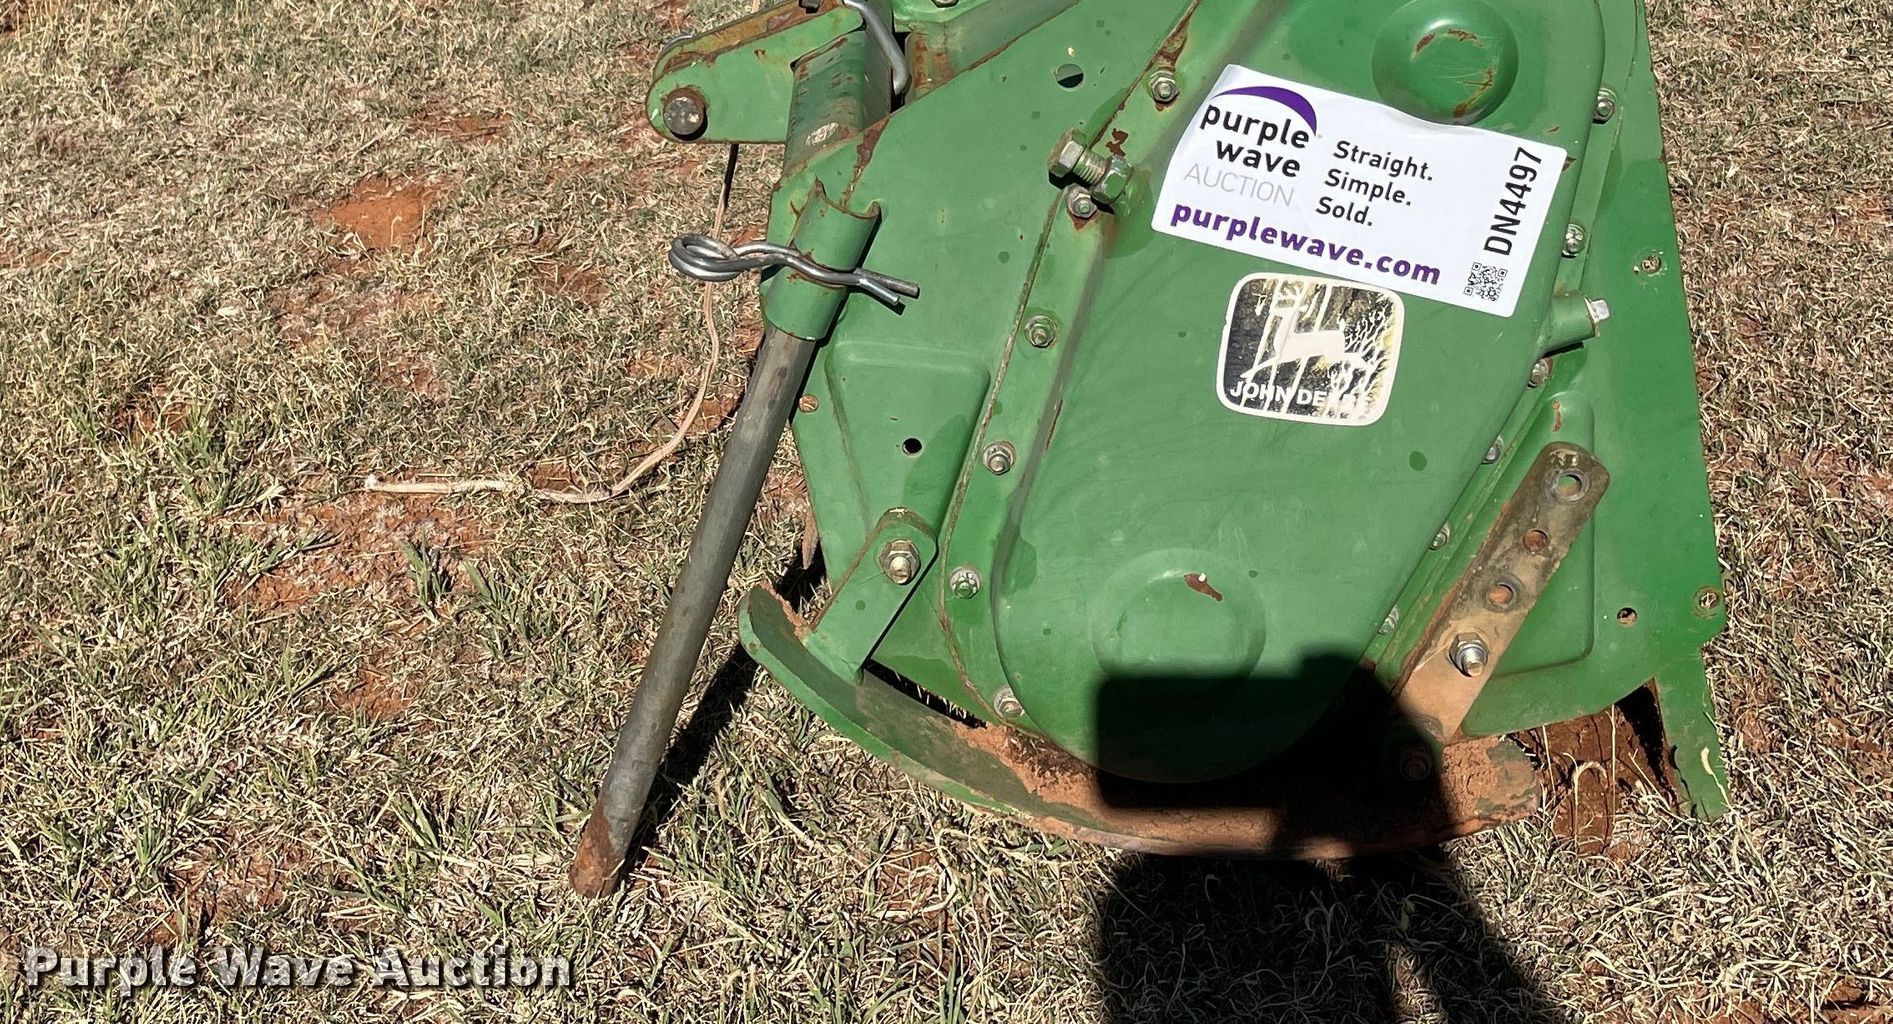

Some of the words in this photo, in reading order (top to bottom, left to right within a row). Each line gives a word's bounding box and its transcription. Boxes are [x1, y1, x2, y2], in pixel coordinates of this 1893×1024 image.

[1199, 103, 1310, 150] purple
[1215, 140, 1301, 178] wave
[1333, 140, 1434, 182] Straight.
[1183, 163, 1295, 207] AUCTION
[1324, 168, 1412, 209] Simple.
[1484, 147, 1543, 256] DN4497
[1315, 196, 1374, 227] Sold.
[1170, 203, 1441, 286] purplewave.com
[1229, 381, 1291, 402] JOHN
